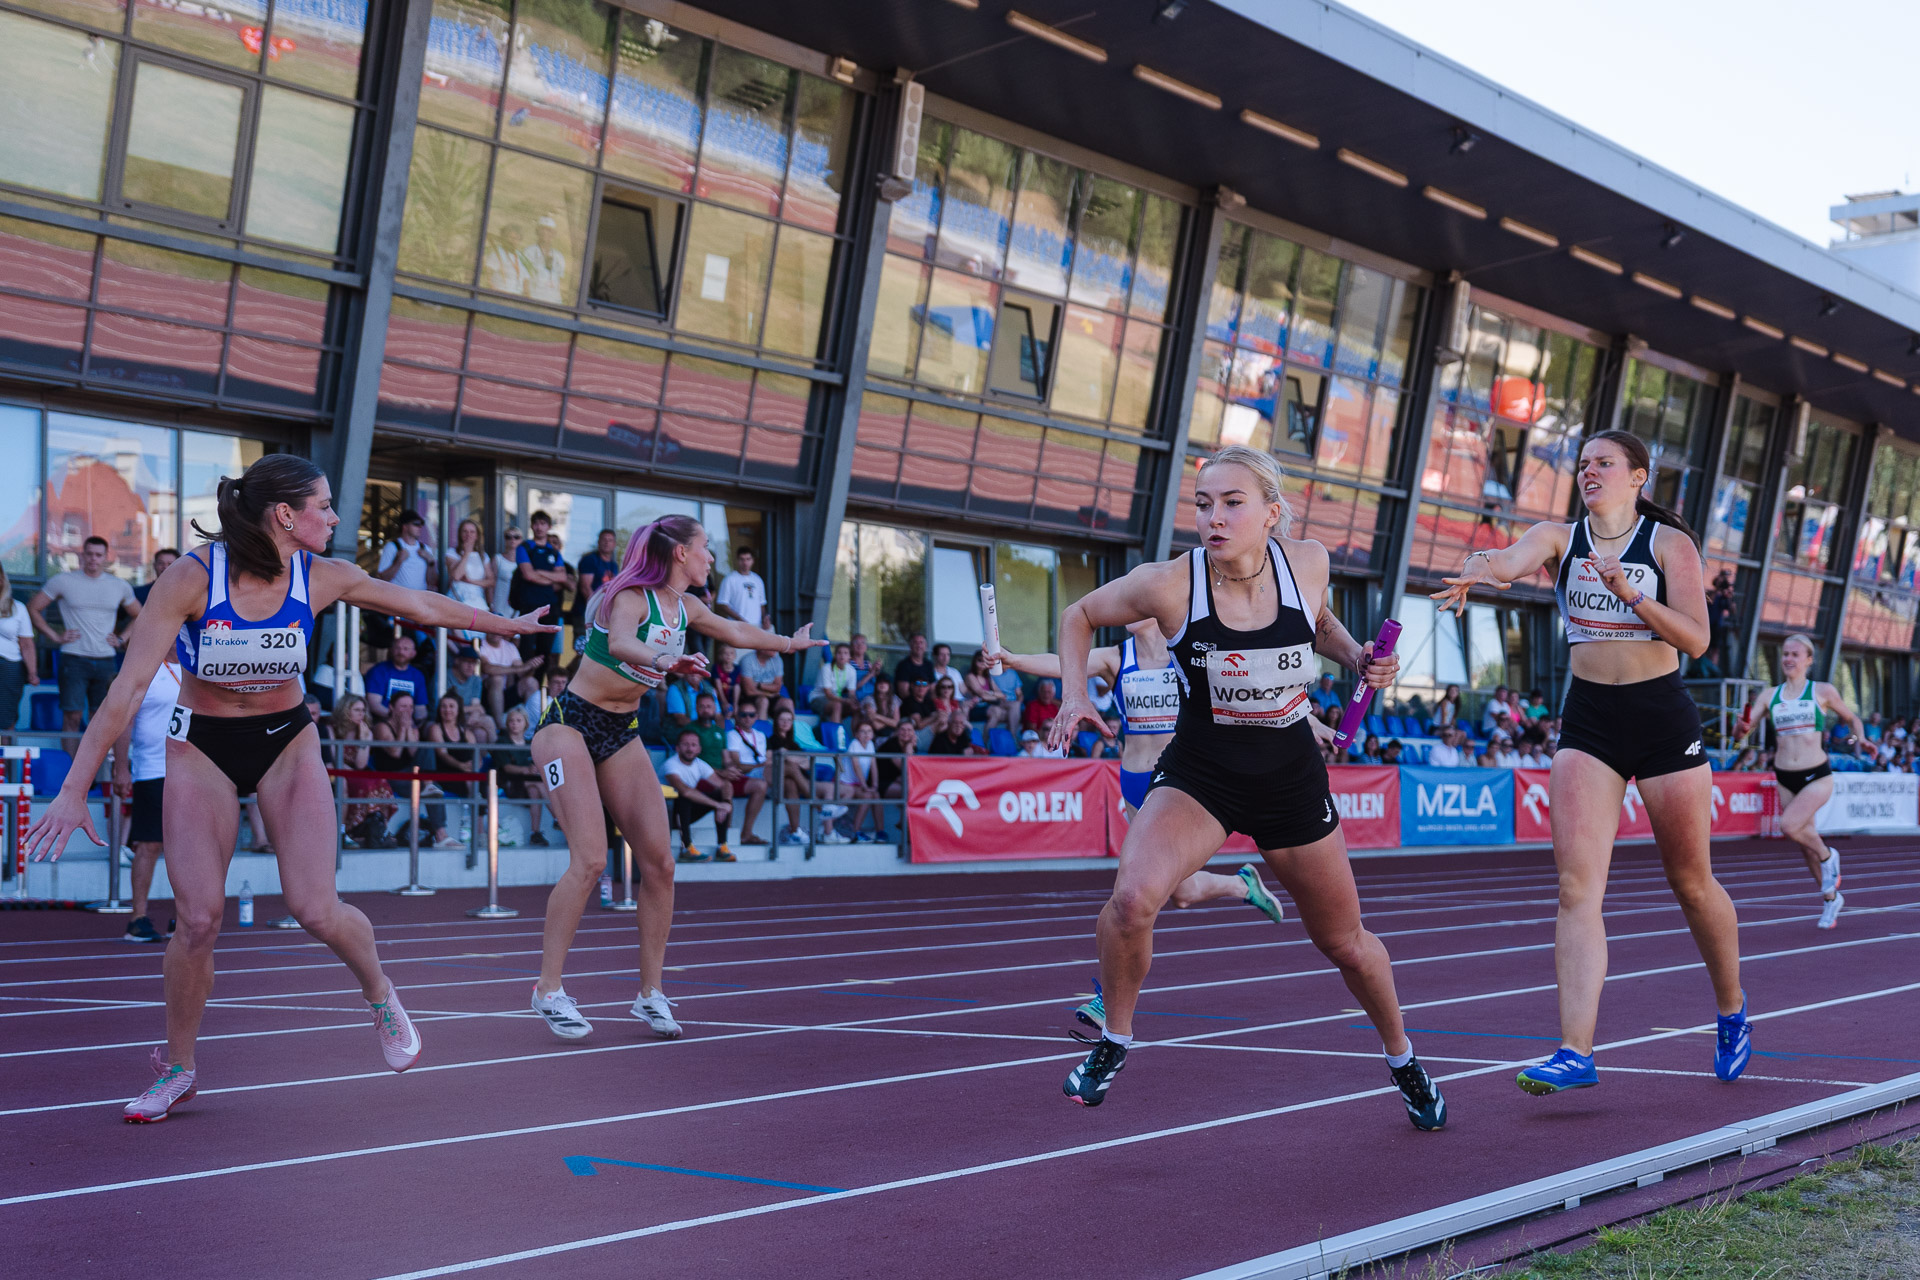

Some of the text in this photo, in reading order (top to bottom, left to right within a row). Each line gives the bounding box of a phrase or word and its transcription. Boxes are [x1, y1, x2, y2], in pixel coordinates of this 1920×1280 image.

[260, 633, 297, 649] 320
[1580, 628, 1614, 638] KRAKÓW
[215, 637, 249, 646] Kraków
[1277, 650, 1302, 670] 83
[202, 662, 301, 677] GUZOWSKA
[169, 706, 184, 736] 5
[1234, 710, 1300, 726] KRAKÓW 2025
[1684, 740, 1702, 756] 4F
[548, 762, 560, 786] 8
[998, 790, 1084, 824] ORLEN
[1416, 783, 1498, 818] MZLA
